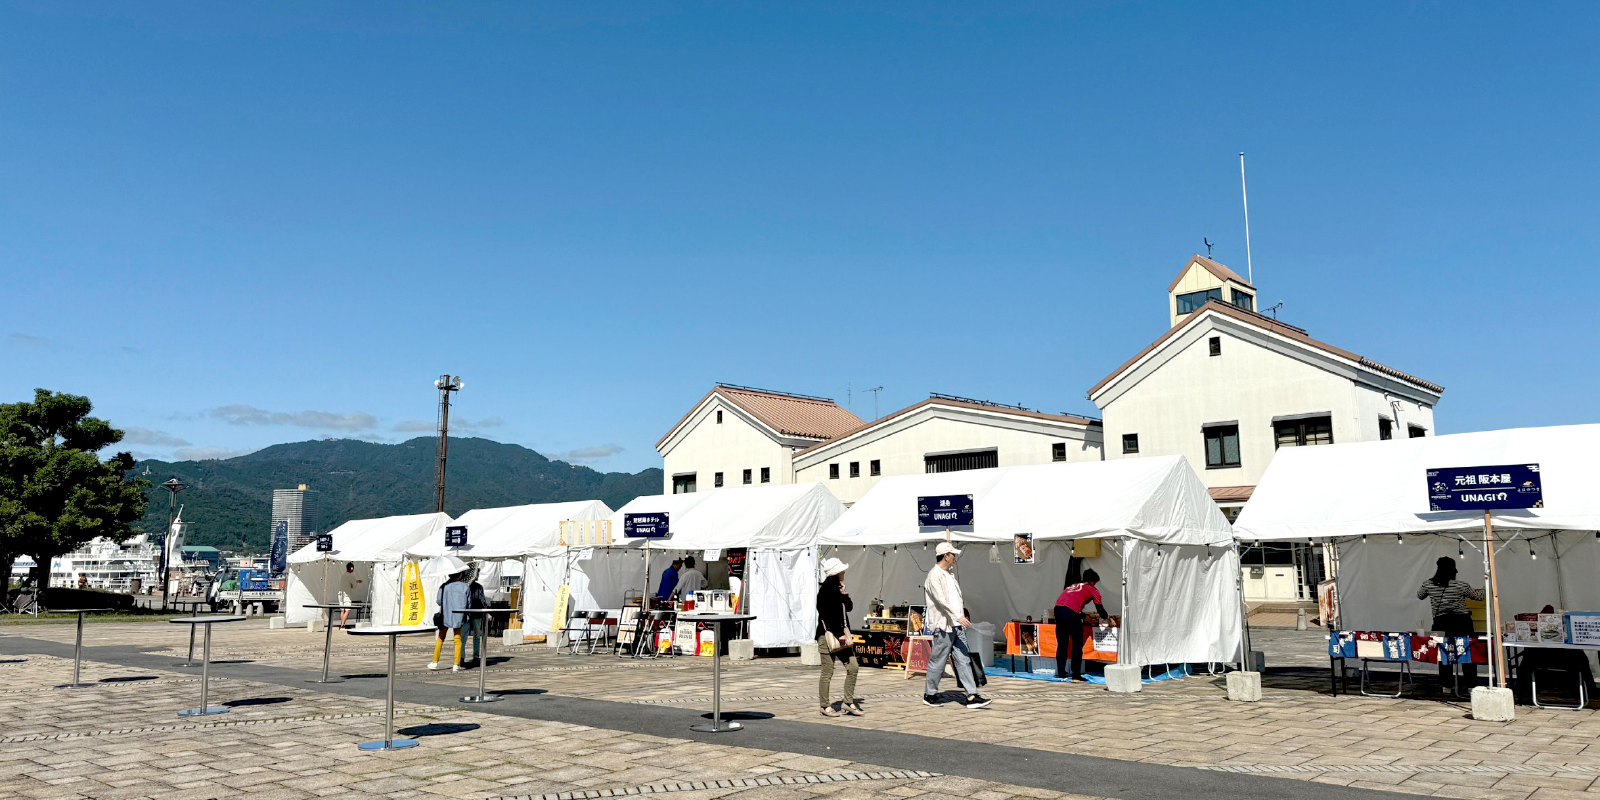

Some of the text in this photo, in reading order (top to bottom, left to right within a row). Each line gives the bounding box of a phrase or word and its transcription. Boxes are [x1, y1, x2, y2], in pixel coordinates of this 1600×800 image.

[1455, 473, 1512, 486] 元祖 阪本屋
[1461, 493, 1496, 503] UNAGI
[933, 512, 951, 521] UNAGI
[409, 581, 420, 621] 近江麦酒
